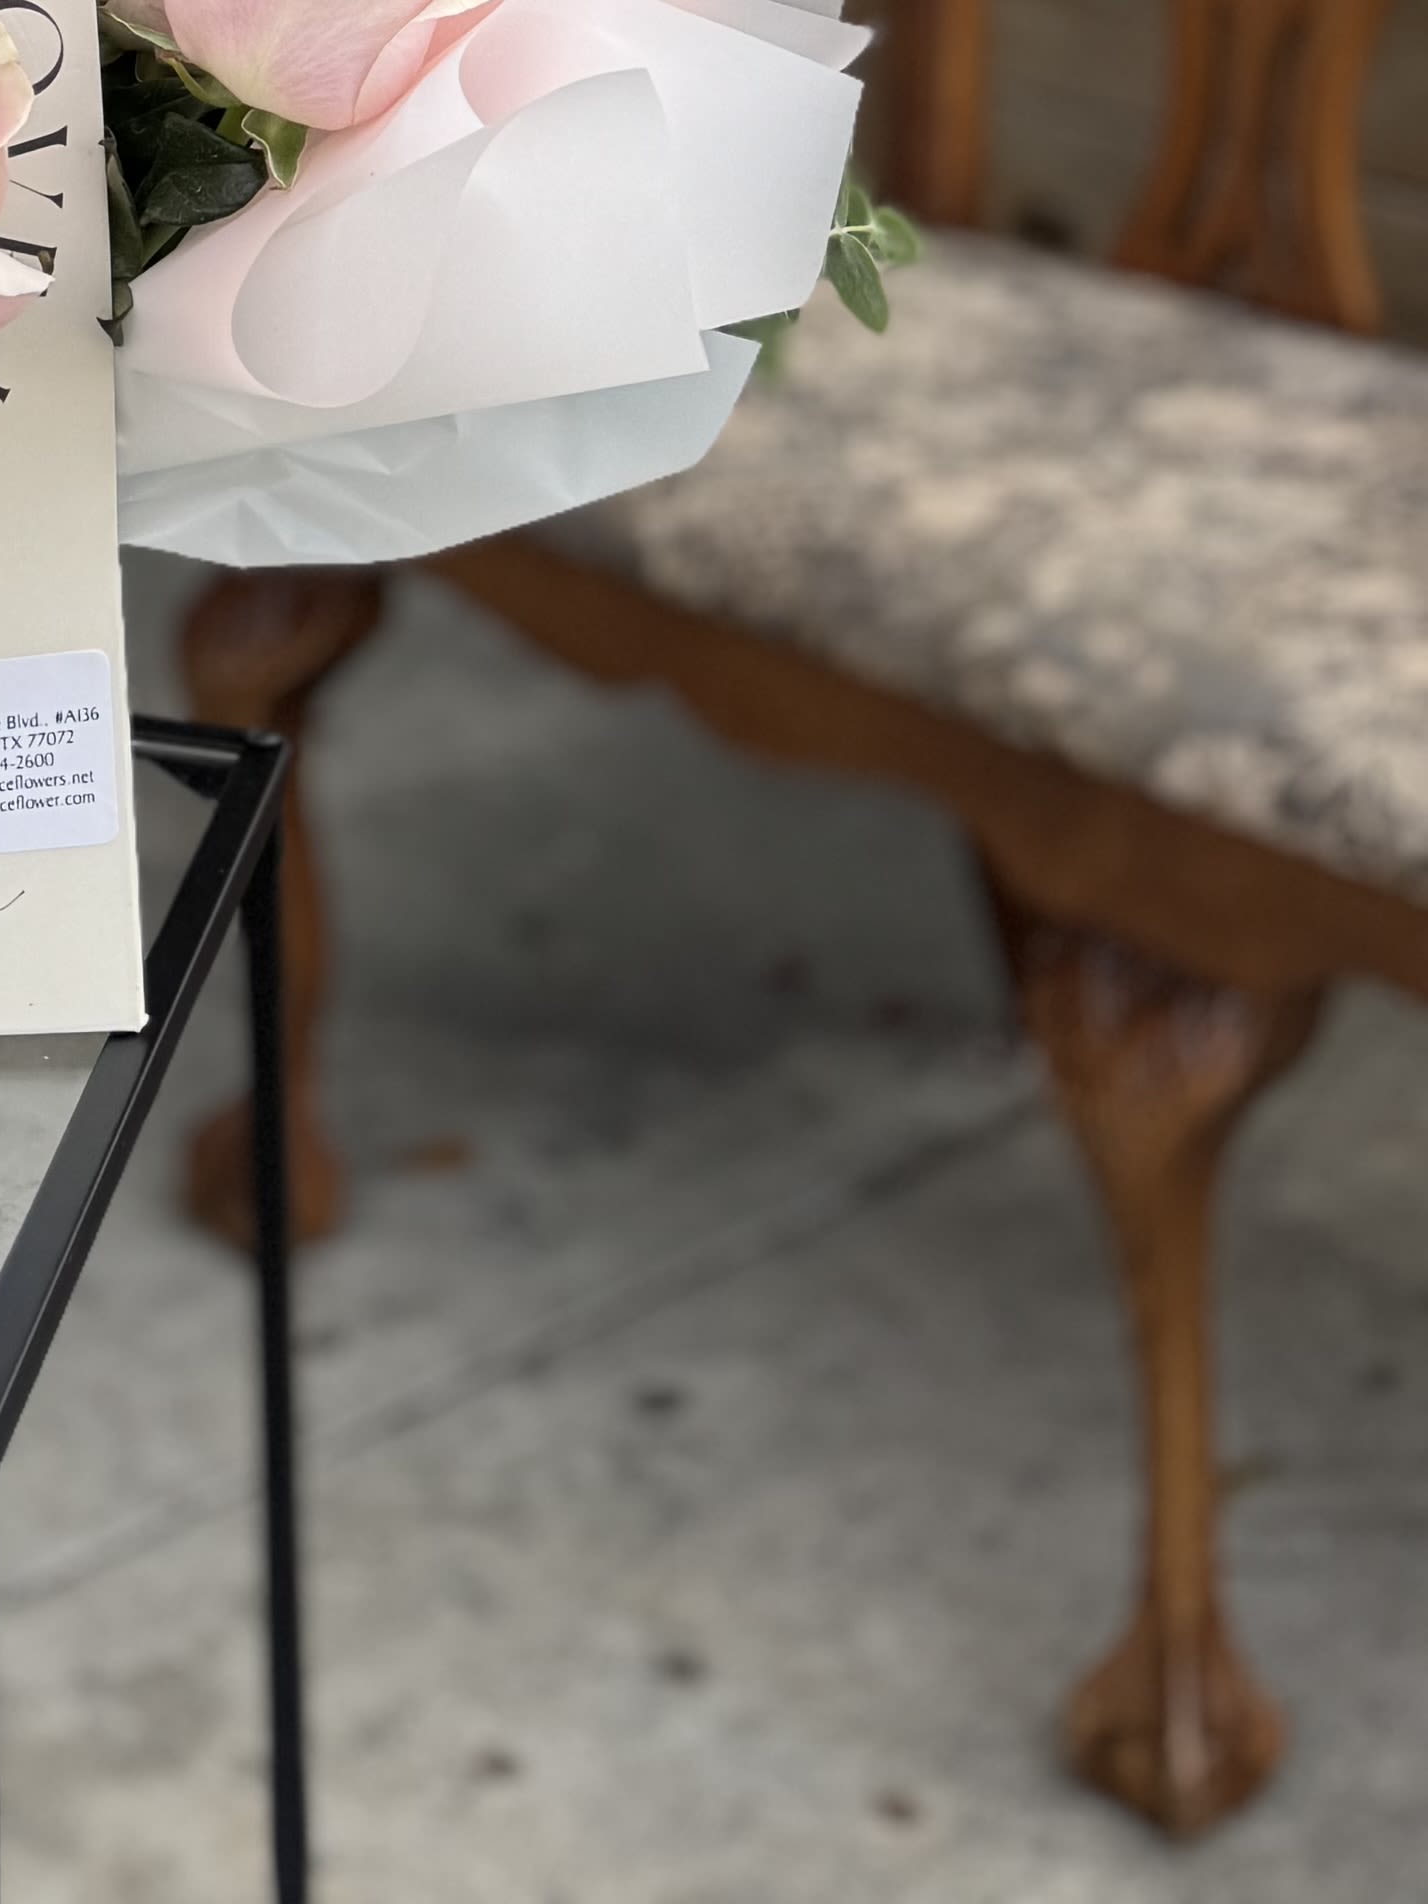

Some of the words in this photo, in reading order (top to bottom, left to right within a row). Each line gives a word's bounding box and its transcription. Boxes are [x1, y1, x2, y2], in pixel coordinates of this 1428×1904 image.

[55, 706, 100, 724] #A136
[0, 735, 23, 751] TX
[27, 729, 75, 749] 77072
